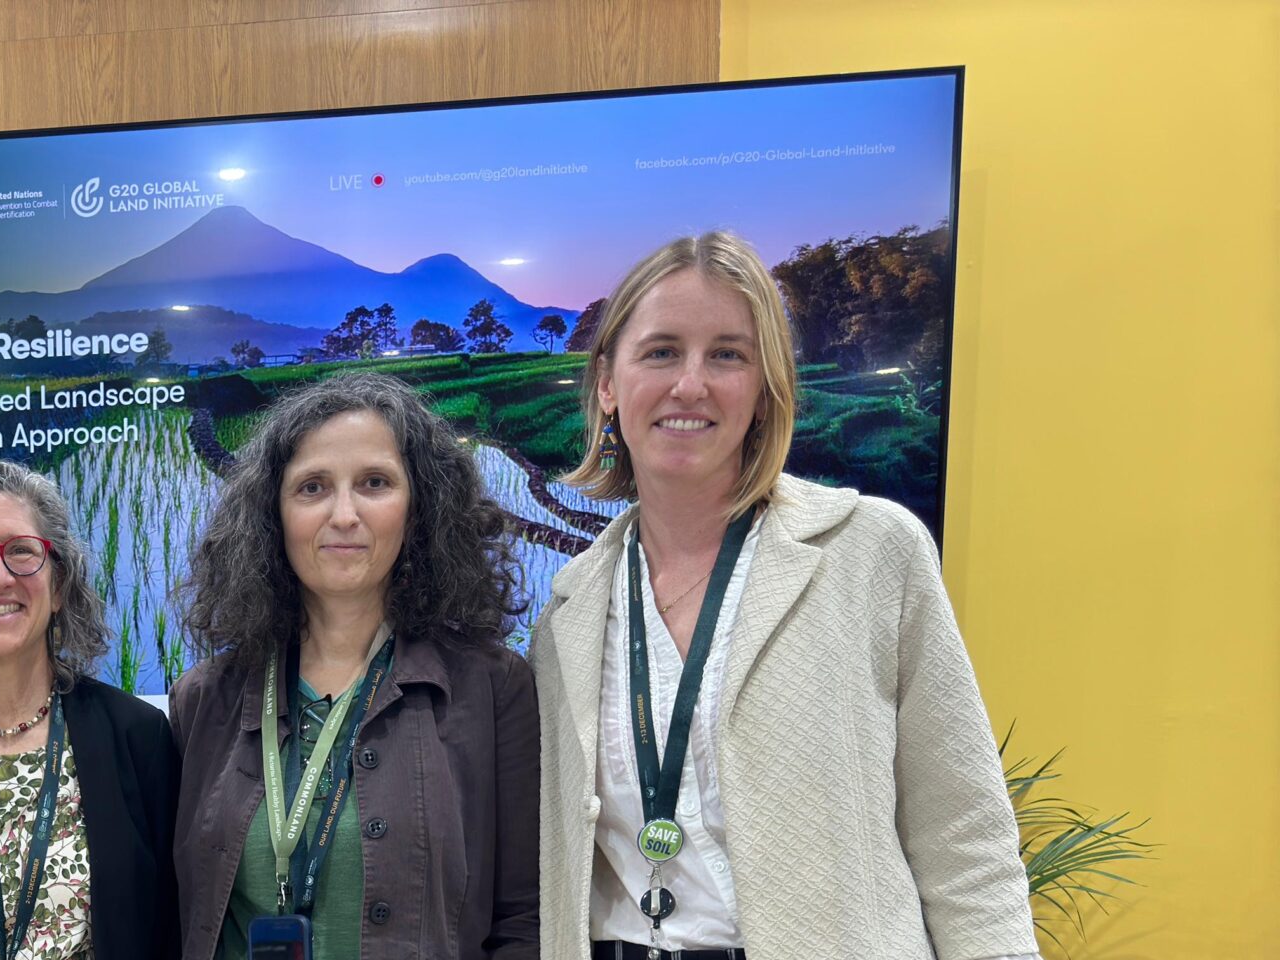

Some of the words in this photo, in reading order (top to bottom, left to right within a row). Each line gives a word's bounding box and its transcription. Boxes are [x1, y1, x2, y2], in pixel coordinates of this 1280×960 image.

[109, 184, 139, 198] G20
[143, 180, 200, 195] GLOBAL
[329, 174, 363, 191] LIVE
[13, 190, 43, 199] Nations
[24, 201, 31, 209] to
[32, 199, 58, 208] Combat
[109, 198, 149, 213] LAND
[153, 193, 225, 210] INITIATIVE
[40, 381, 186, 411] Landscape
[11, 417, 138, 453] Approach
[287, 767, 317, 840] COMMONLAND
[318, 831, 328, 847] OUR
[329, 800, 339, 815] OUR
[647, 825, 679, 843] SAVE
[645, 838, 671, 855] SOIL
[30, 858, 40, 890] DECEMBER
